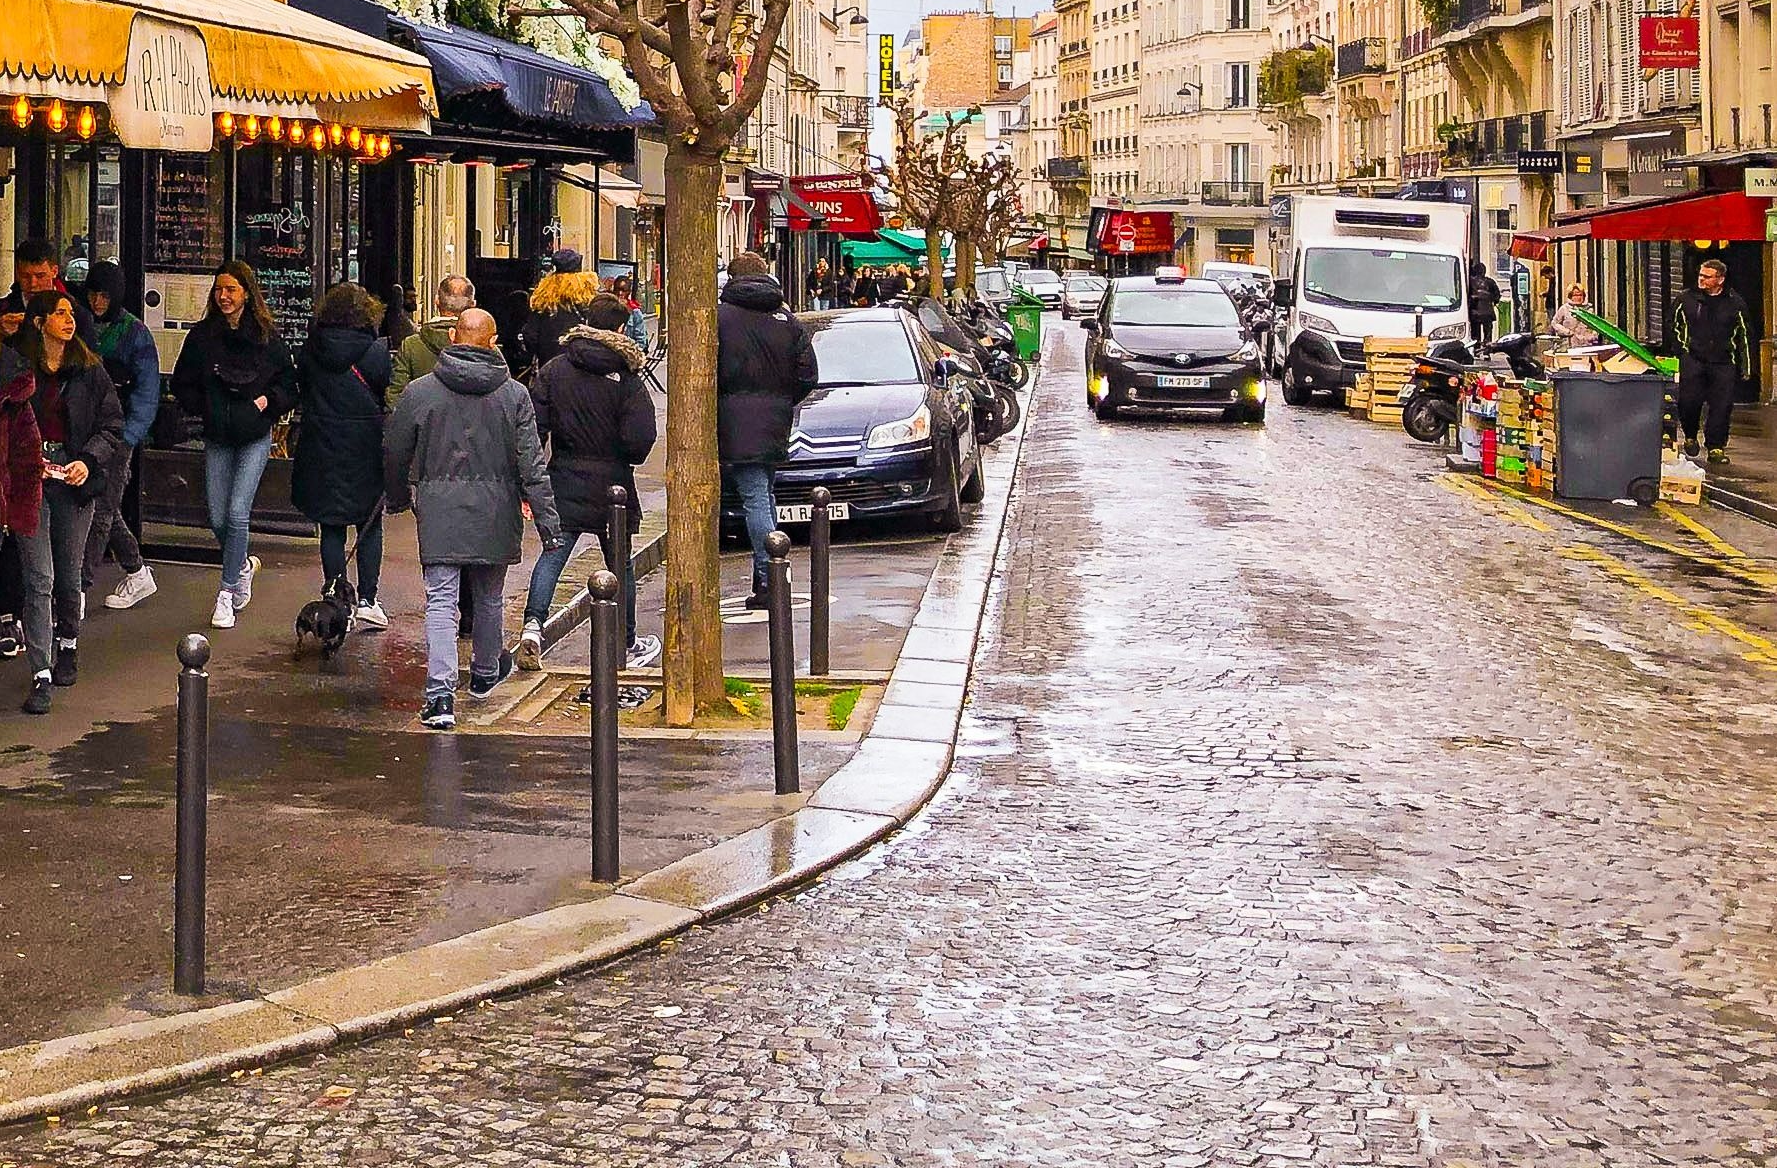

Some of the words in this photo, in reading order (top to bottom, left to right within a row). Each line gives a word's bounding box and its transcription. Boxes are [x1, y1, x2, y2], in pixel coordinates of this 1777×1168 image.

[133, 34, 169, 113] VRAI
[169, 34, 206, 117] PARIS
[880, 35, 893, 92] HOTEL
[779, 507, 793, 520] 41
[827, 505, 844, 518] 75
